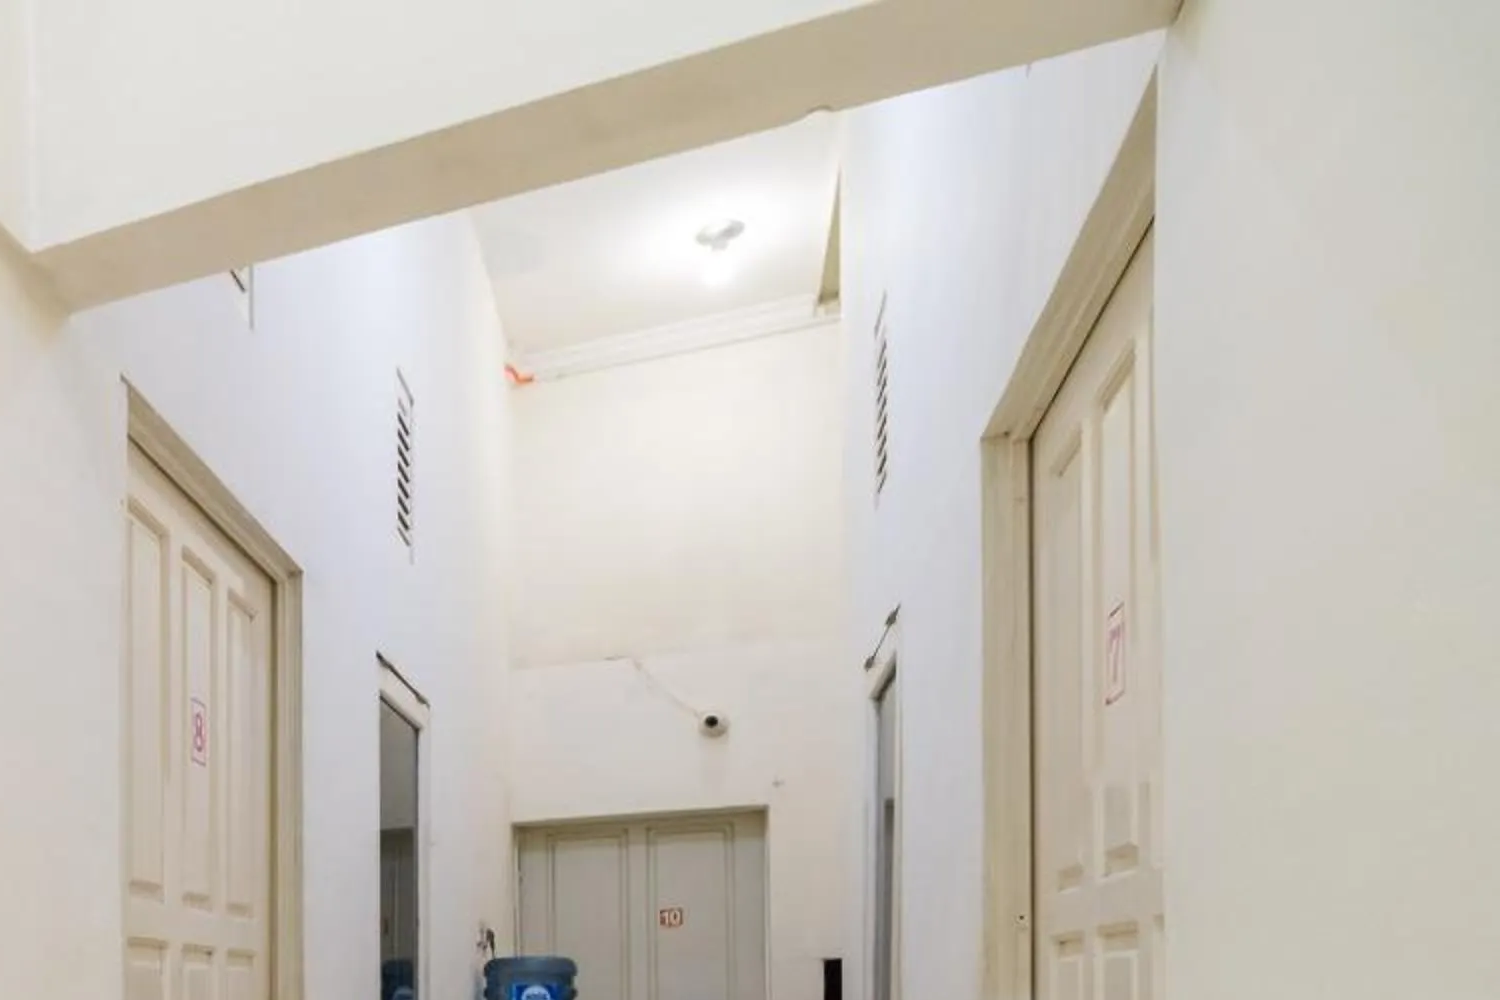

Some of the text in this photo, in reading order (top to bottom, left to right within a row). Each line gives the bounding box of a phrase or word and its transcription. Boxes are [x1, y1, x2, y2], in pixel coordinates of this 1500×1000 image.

[1107, 622, 1121, 684] 7
[193, 711, 206, 753] 8
[660, 909, 682, 927] 10
